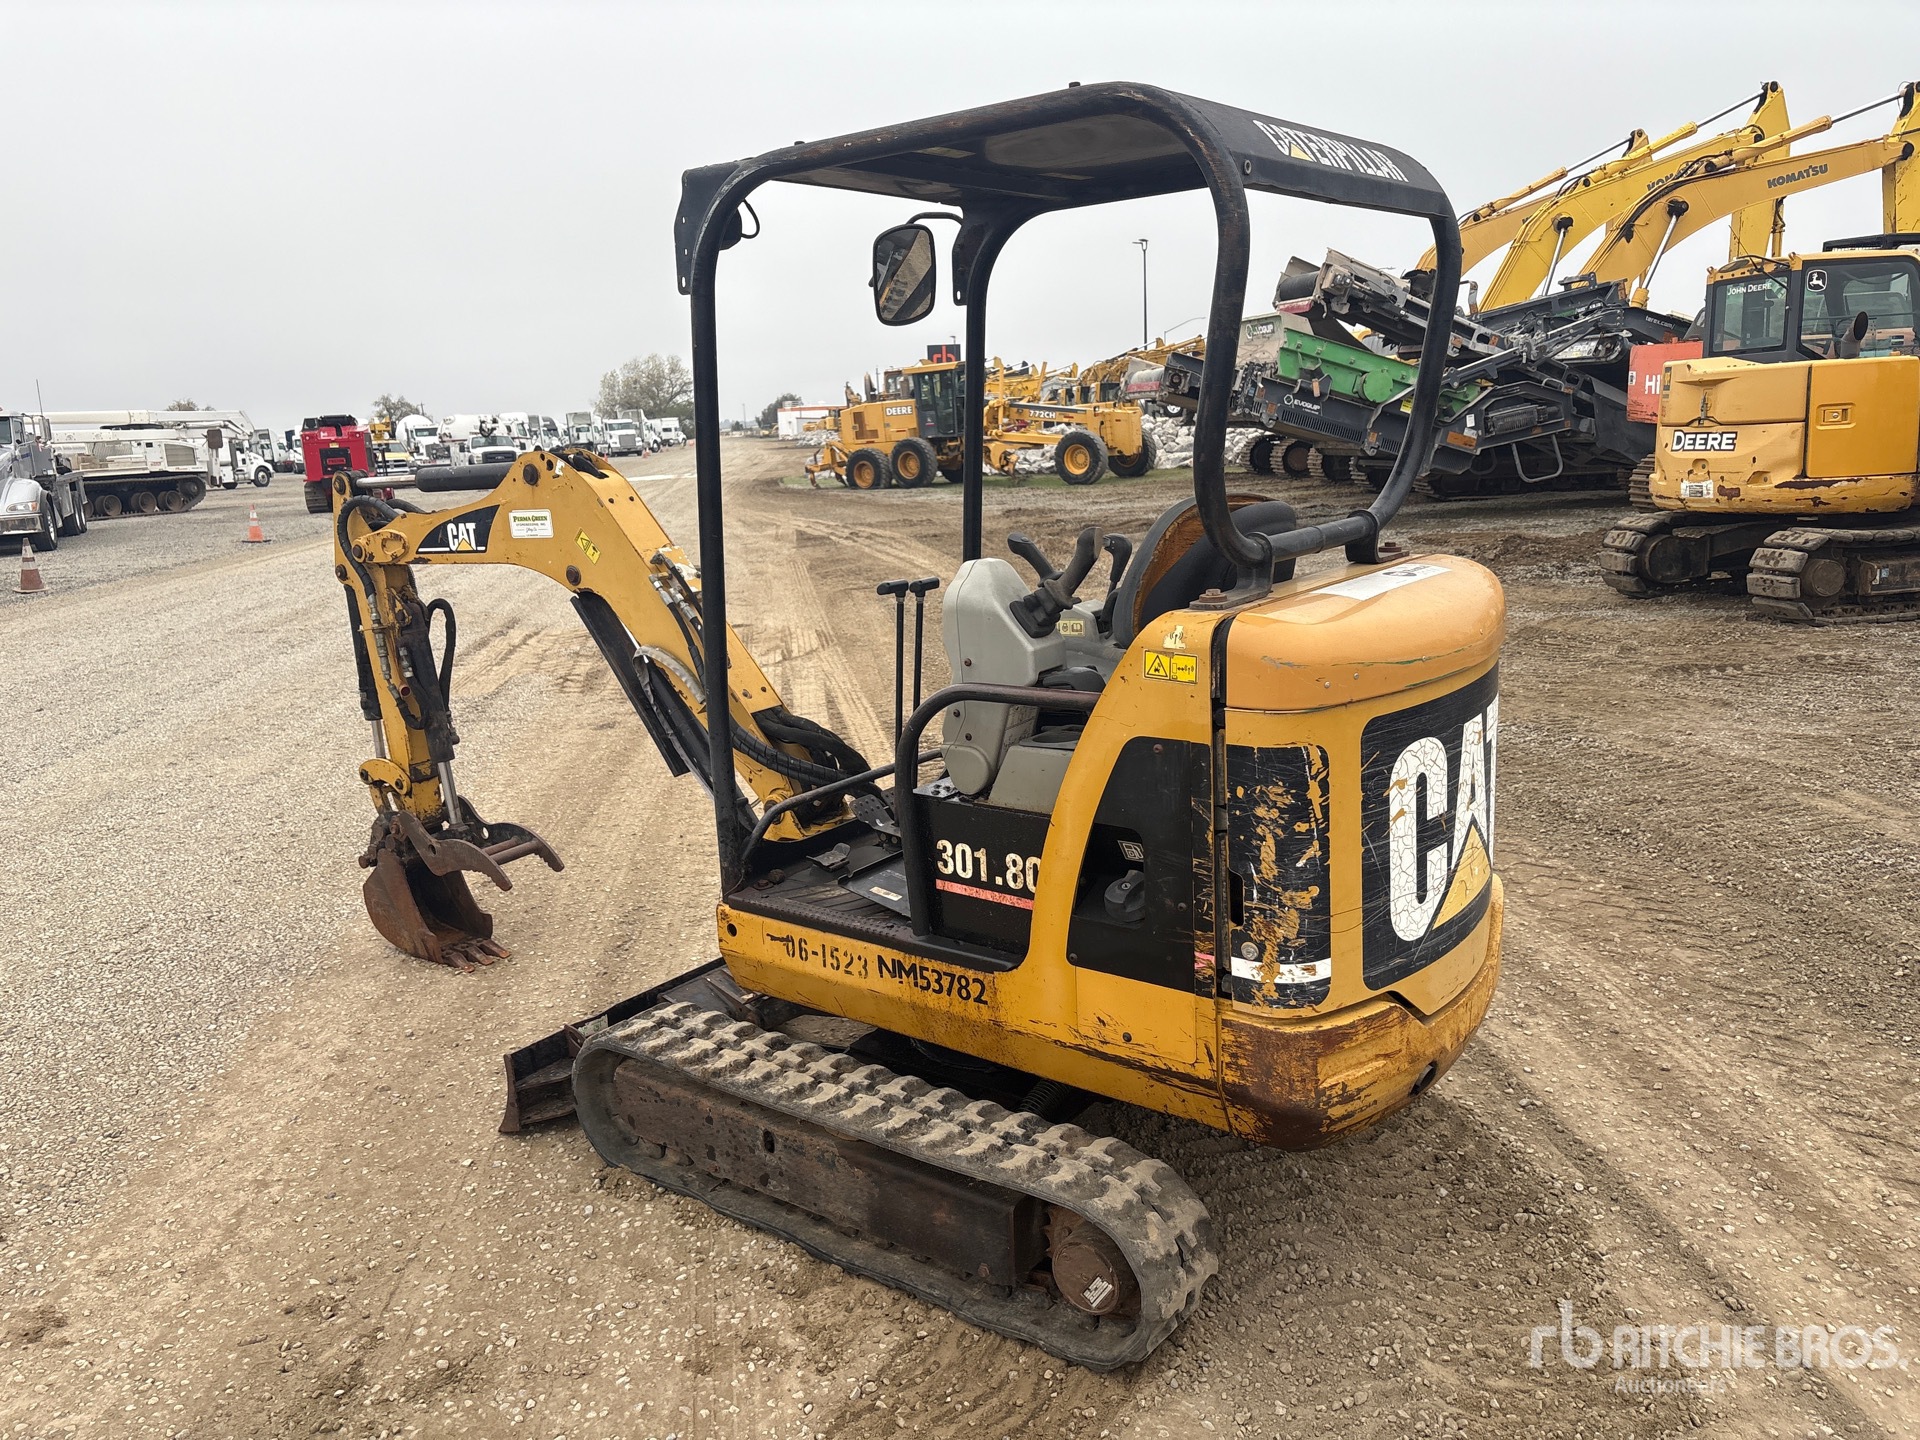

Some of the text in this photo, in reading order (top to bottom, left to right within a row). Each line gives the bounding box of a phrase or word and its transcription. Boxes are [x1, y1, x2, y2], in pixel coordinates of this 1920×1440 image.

[1253, 120, 1409, 182] CATERPILLAR
[1767, 164, 1828, 188] KOMATSU
[1727, 282, 1772, 296] JOHN DEERE
[886, 406, 913, 416] DEERE
[1029, 410, 1056, 419] 772CH
[1294, 399, 1320, 410] EVOQUIP
[1671, 430, 1738, 451] DEERE
[446, 522, 477, 552] CAT
[1389, 693, 1499, 942] CAT
[785, 934, 989, 1006] 06-1523 NM53782
